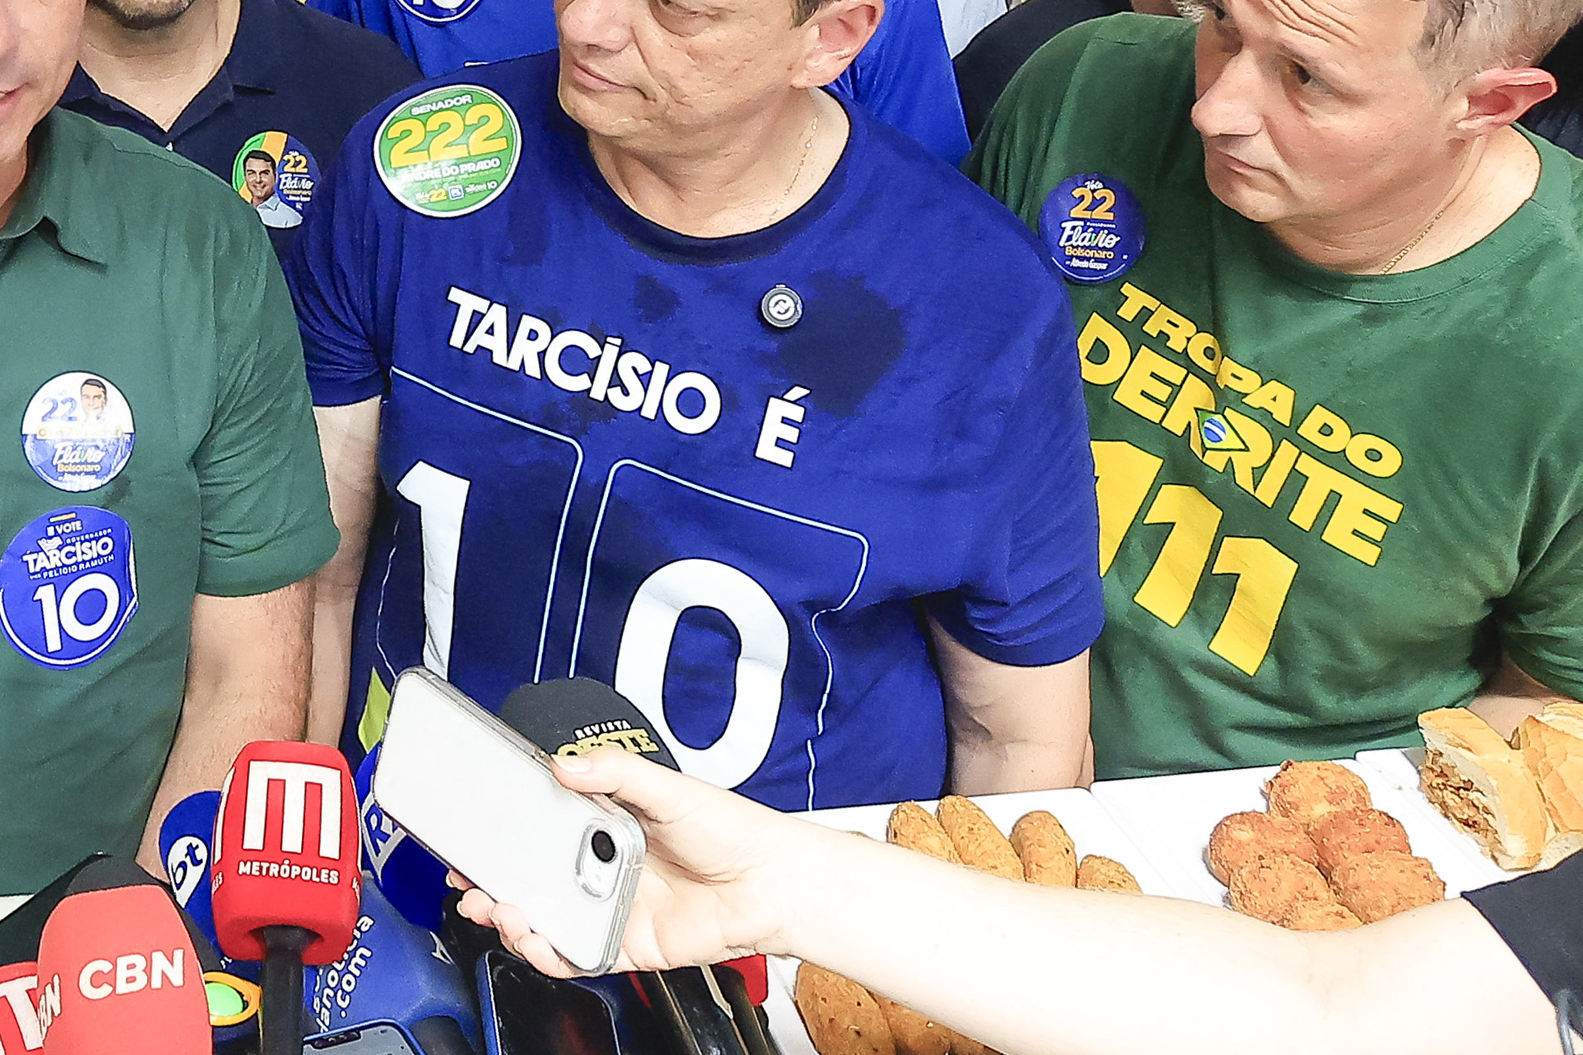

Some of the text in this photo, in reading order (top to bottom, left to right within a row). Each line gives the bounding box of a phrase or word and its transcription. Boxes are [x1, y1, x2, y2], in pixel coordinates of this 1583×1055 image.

[410, 93, 473, 116] SENADOR
[387, 103, 509, 168] 222
[283, 154, 309, 173] 22
[442, 165, 460, 178] DO
[459, 157, 501, 174] PRADO
[430, 188, 448, 203] 22
[1069, 186, 1117, 221] 22
[1058, 220, 1122, 249] Flávio
[1064, 246, 1115, 260] Bolsonaro
[445, 286, 812, 468] TARCÍSIO É
[1116, 281, 1404, 479] TROPA DO
[40, 396, 79, 423] 22
[1076, 311, 1405, 567] DERRITE
[55, 520, 83, 535] VOTE
[21, 536, 115, 574] TARCÍSIO
[78, 553, 115, 571] RAMUTH
[1089, 439, 1300, 677] 111
[32, 571, 122, 654] 10
[395, 460, 792, 792] 10
[574, 720, 632, 740] REVISTA
[238, 859, 340, 885] METRÓPOLES
[78, 947, 186, 1001] CBN
[336, 945, 373, 1019] .com
